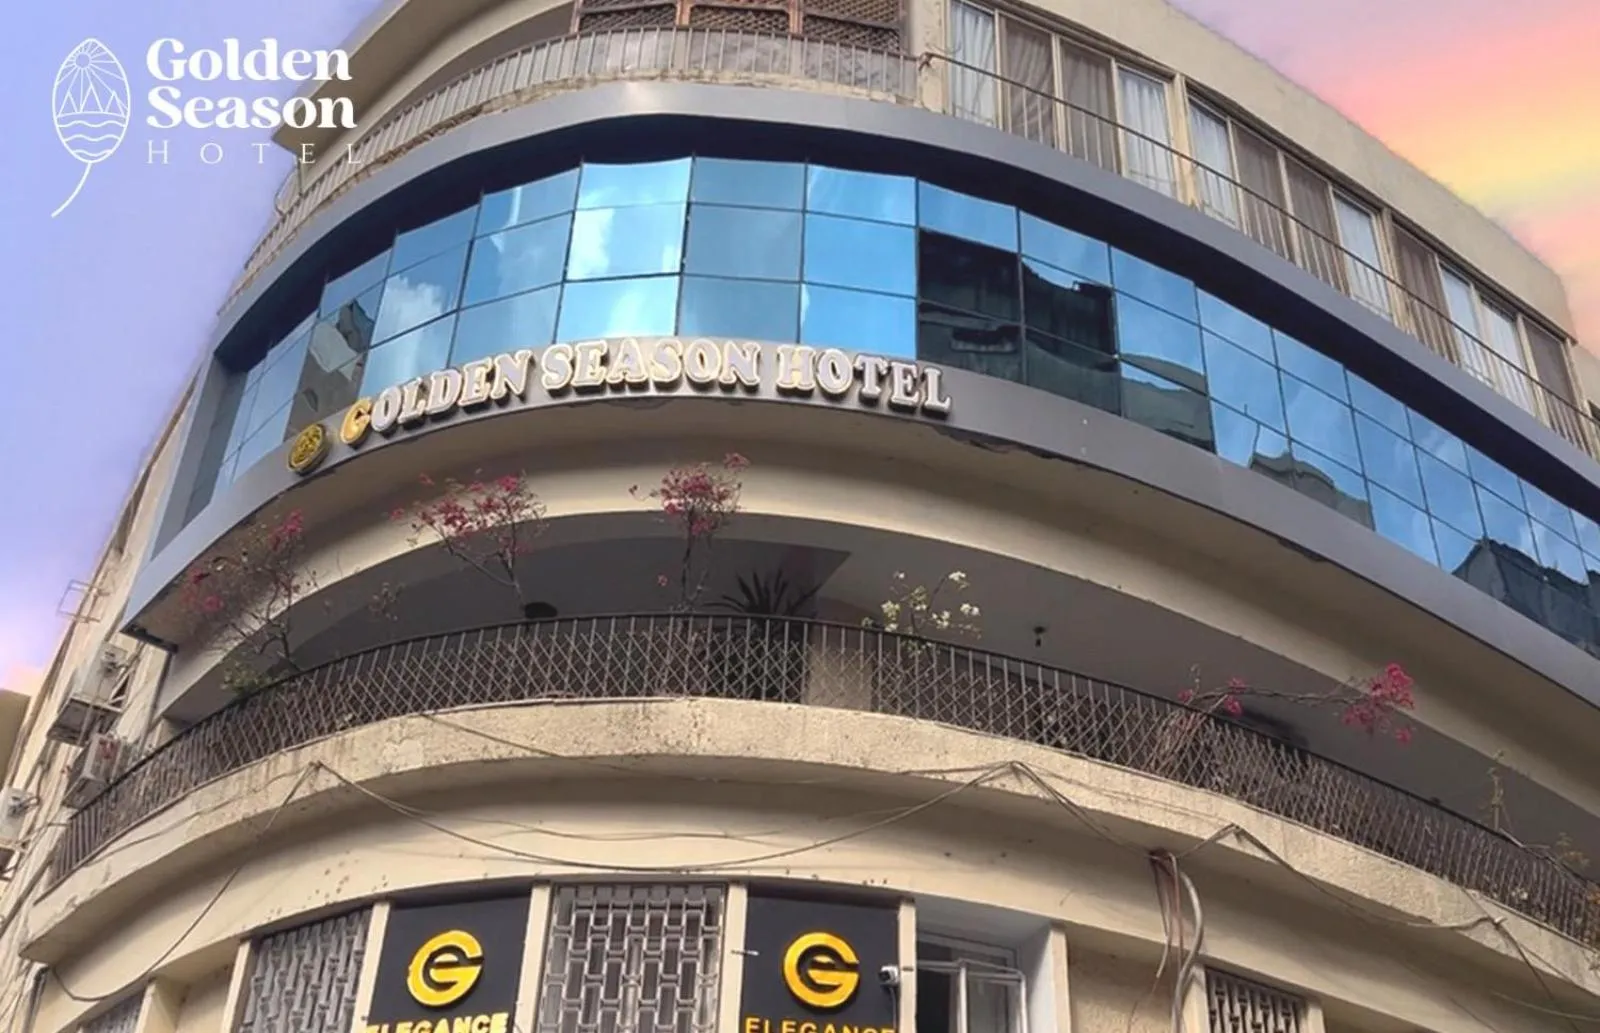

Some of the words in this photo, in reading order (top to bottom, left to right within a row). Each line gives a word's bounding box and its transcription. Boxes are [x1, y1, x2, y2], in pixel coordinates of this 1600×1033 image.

[340, 349, 534, 446] GOLDEN
[540, 336, 762, 391] SEASON
[775, 345, 952, 414] HOTEL
[745, 1017, 896, 1033] ELEGA
